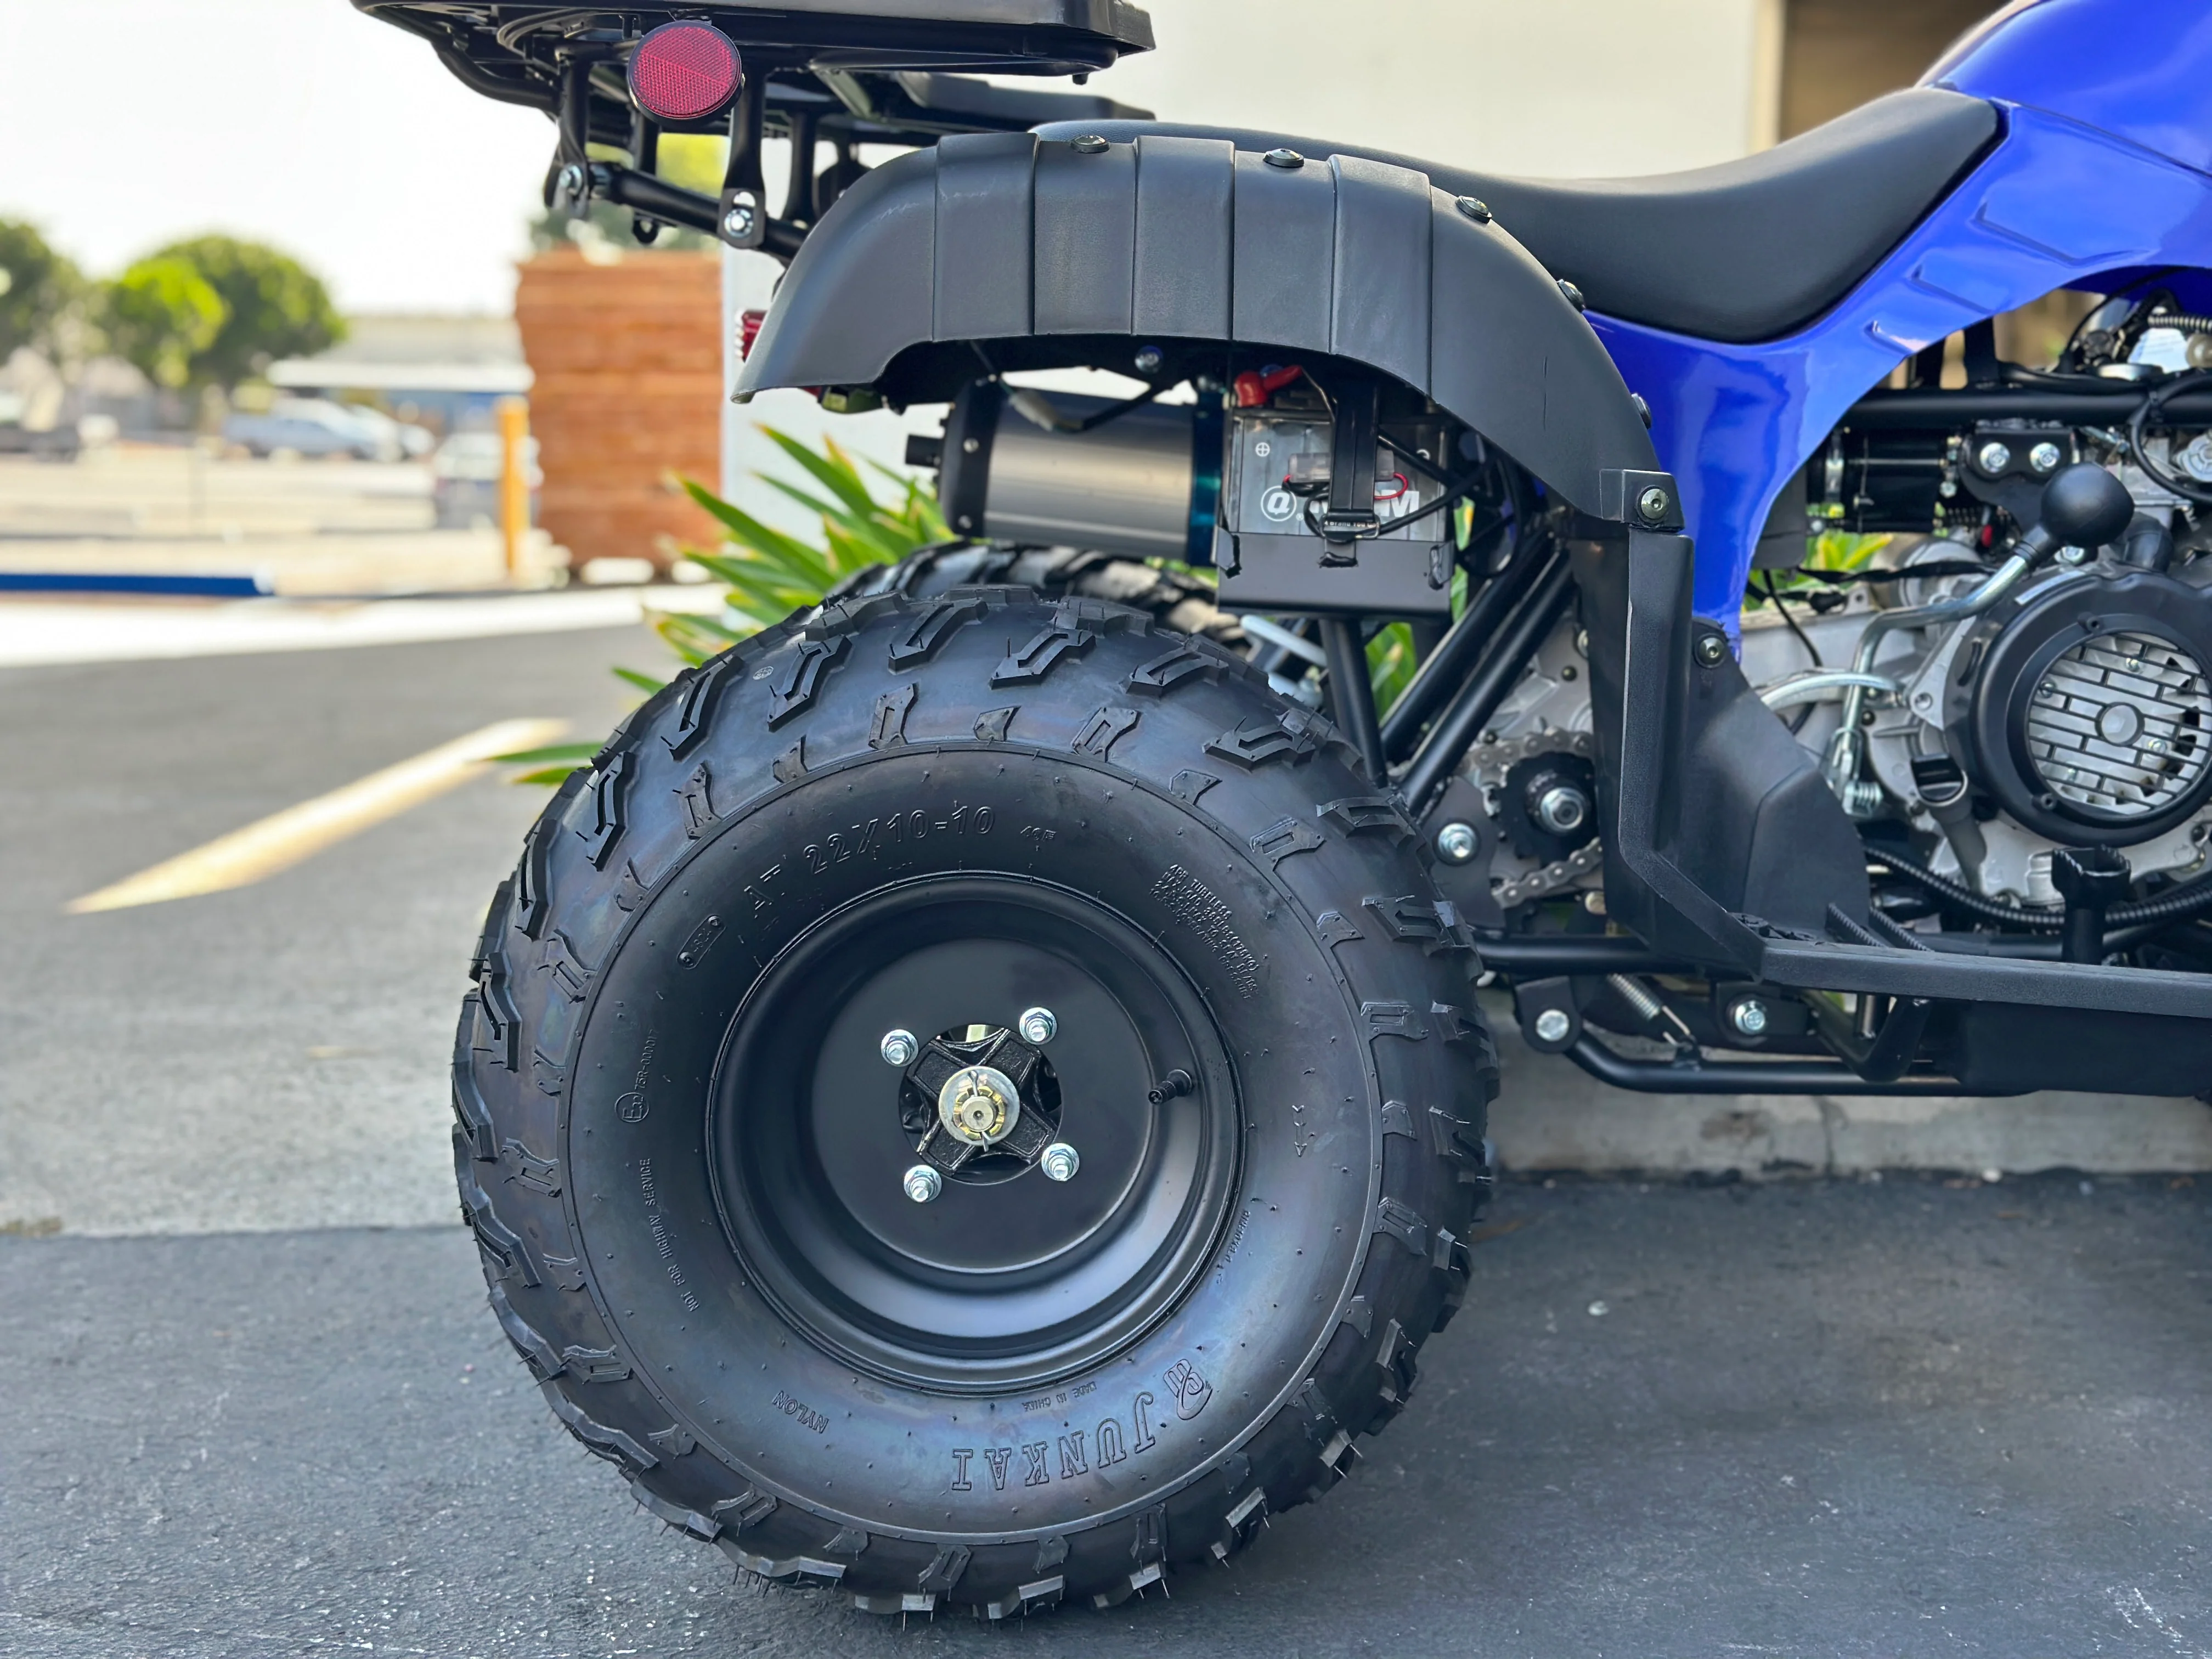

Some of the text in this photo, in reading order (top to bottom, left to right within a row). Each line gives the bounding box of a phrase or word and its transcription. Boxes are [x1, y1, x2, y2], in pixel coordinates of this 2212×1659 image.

[743, 805, 995, 919] AT 22X10-10
[639, 1158, 699, 1312] NOT FOR HIGHWAY SERVICE
[771, 1390, 830, 1434] NYLON
[1022, 1397, 1052, 1412] CHINA
[1056, 1392, 1068, 1403] IN
[952, 1391, 1156, 1492] JUNKAI
